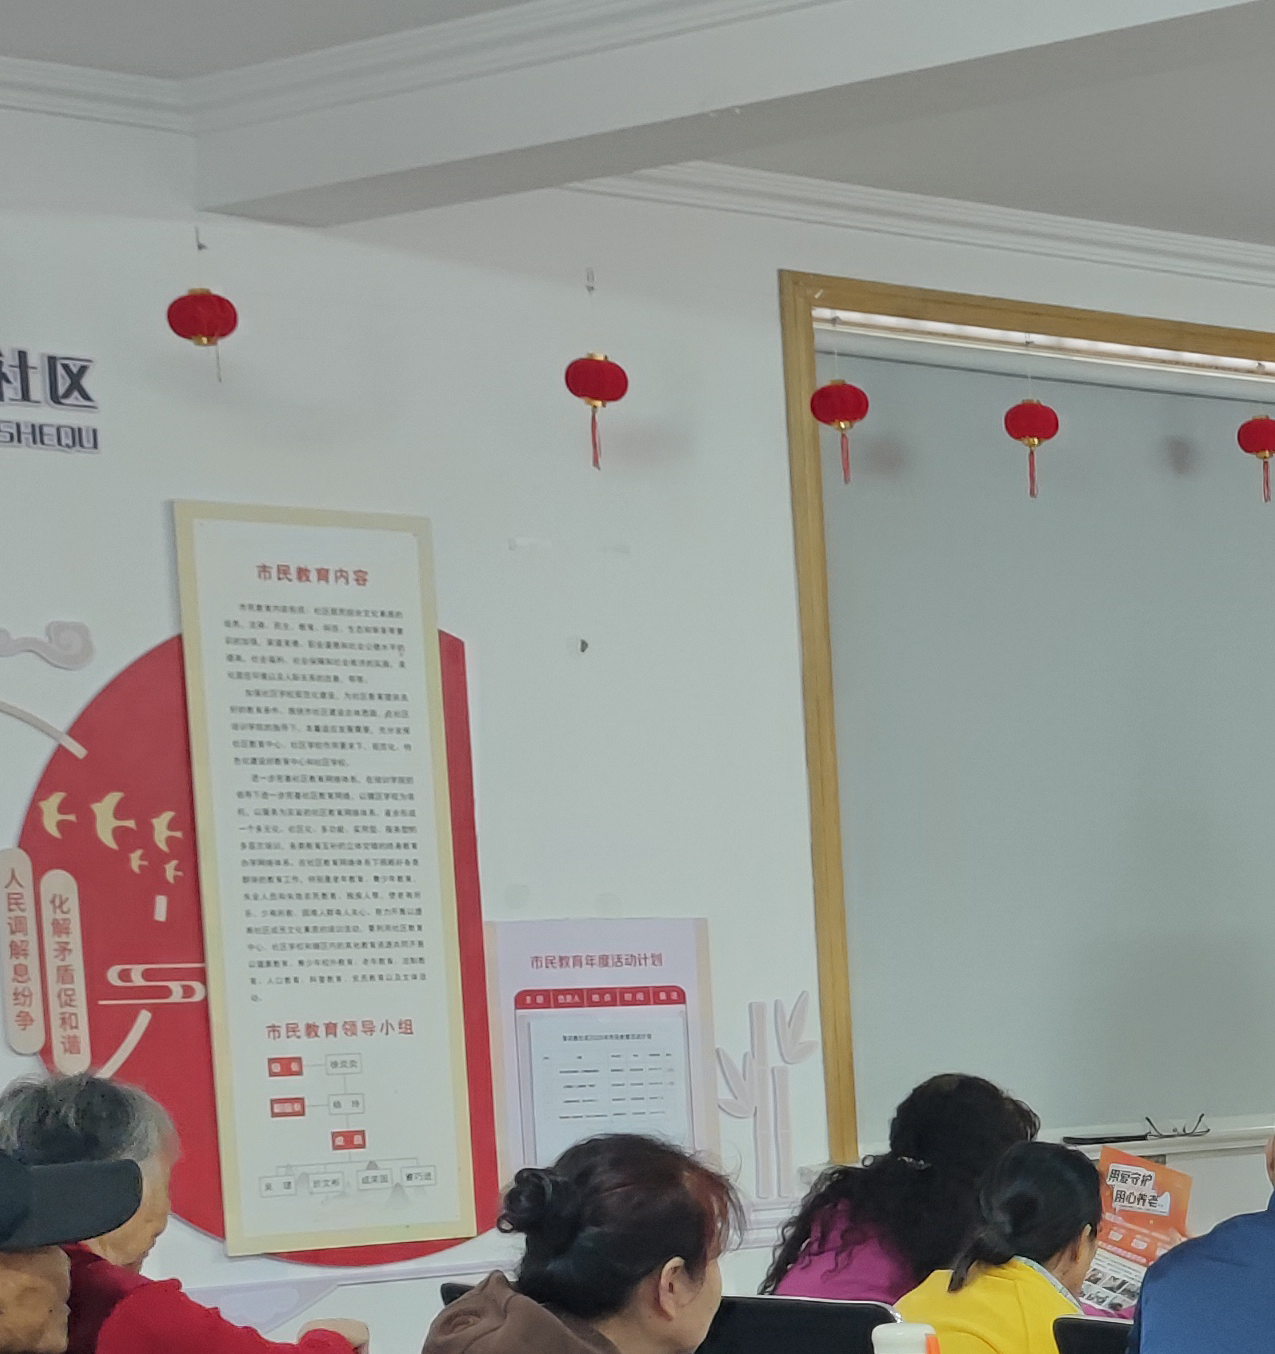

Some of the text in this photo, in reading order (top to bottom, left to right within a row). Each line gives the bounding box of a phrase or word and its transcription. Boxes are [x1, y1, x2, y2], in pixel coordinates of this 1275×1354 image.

[0, 349, 98, 409] 社区
[0, 420, 98, 450] SHEQU
[256, 563, 368, 587] 市民教育内容
[4, 867, 35, 1031] 人民调解息纷争
[530, 952, 663, 970] 市民教育年度活动计划
[49, 893, 81, 1055] 化解矛盾促和谐
[266, 1018, 414, 1041] 市民教育领导小组
